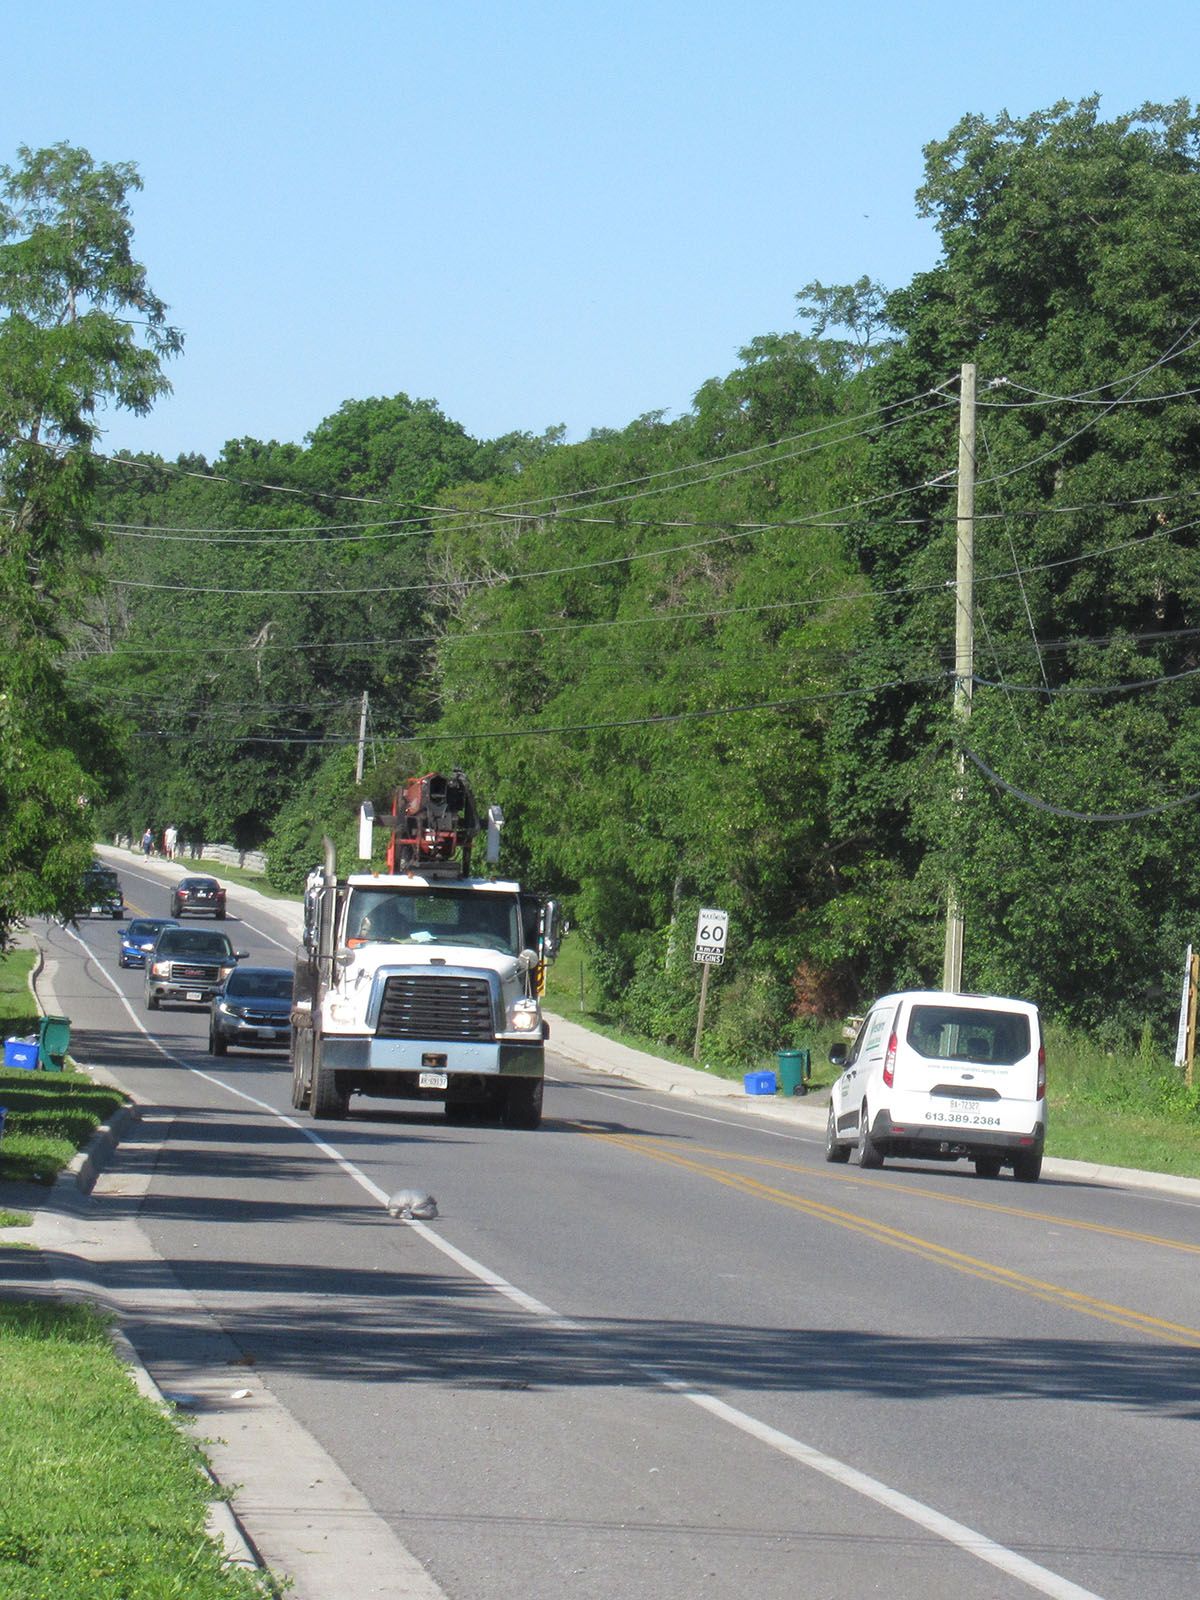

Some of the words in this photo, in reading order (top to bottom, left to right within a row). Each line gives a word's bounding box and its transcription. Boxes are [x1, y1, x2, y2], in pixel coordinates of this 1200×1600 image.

[700, 925, 724, 941] 60
[696, 953, 721, 963] BEGINS
[925, 1112, 1001, 1126] 613.389.2384
